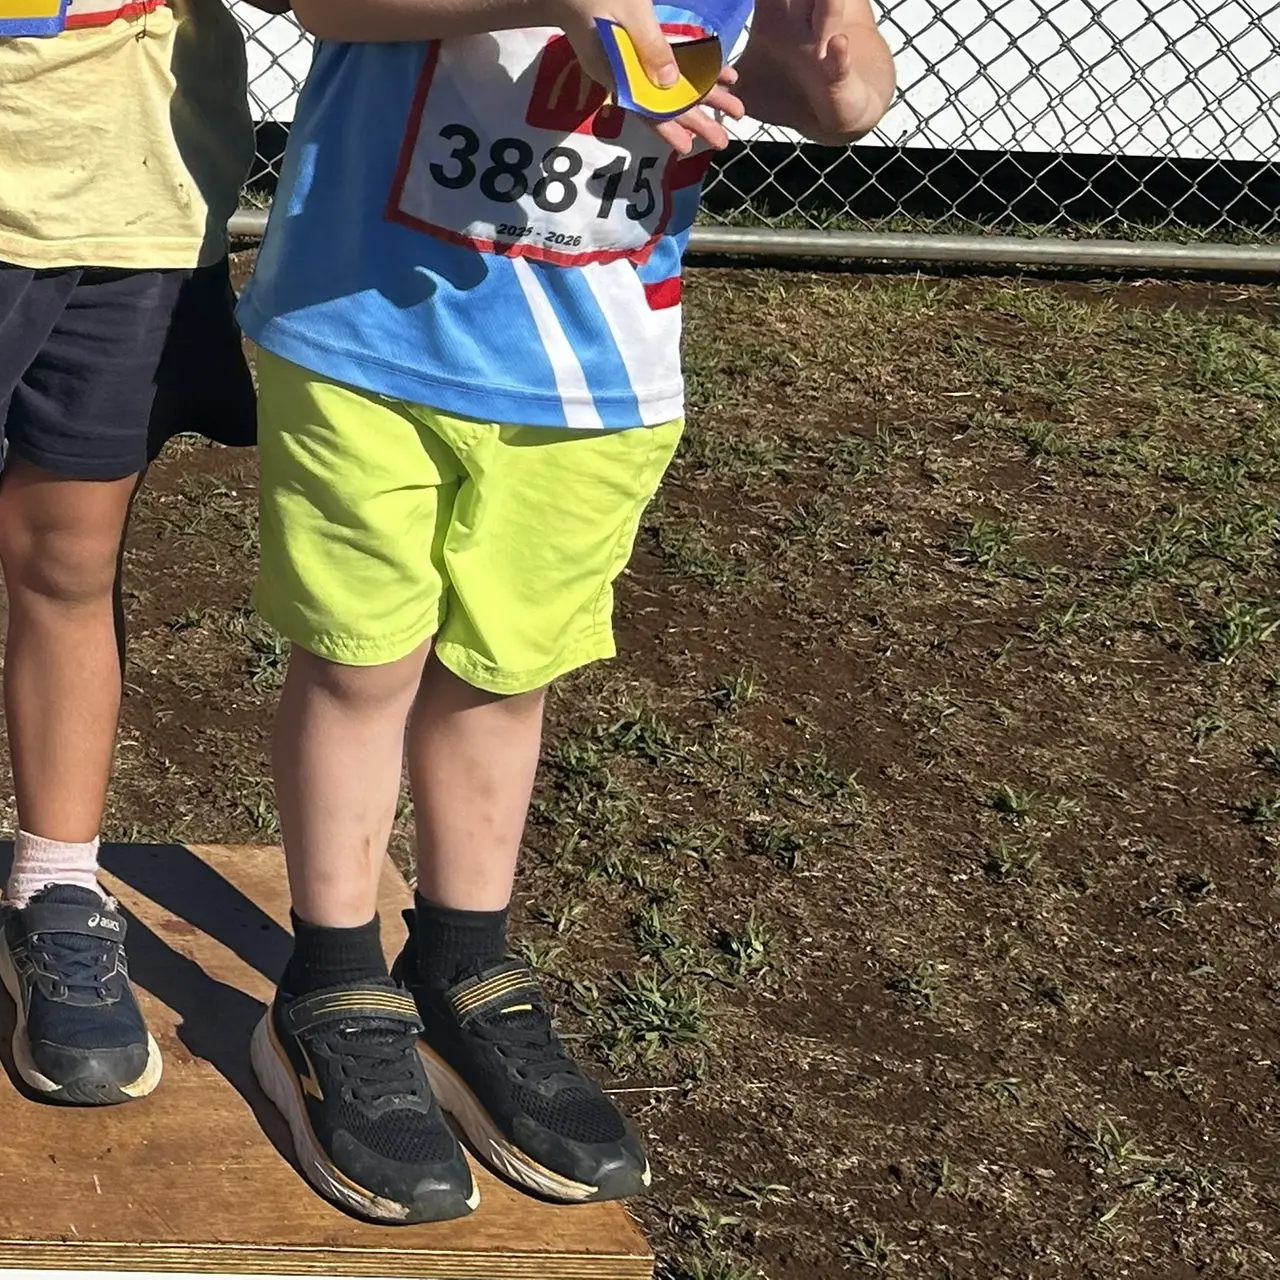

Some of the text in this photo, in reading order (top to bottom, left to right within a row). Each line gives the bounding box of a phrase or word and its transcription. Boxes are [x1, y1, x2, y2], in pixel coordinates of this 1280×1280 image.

[429, 123, 659, 221] 38815
[496, 223, 534, 237] 2025
[544, 231, 582, 247] 2026
